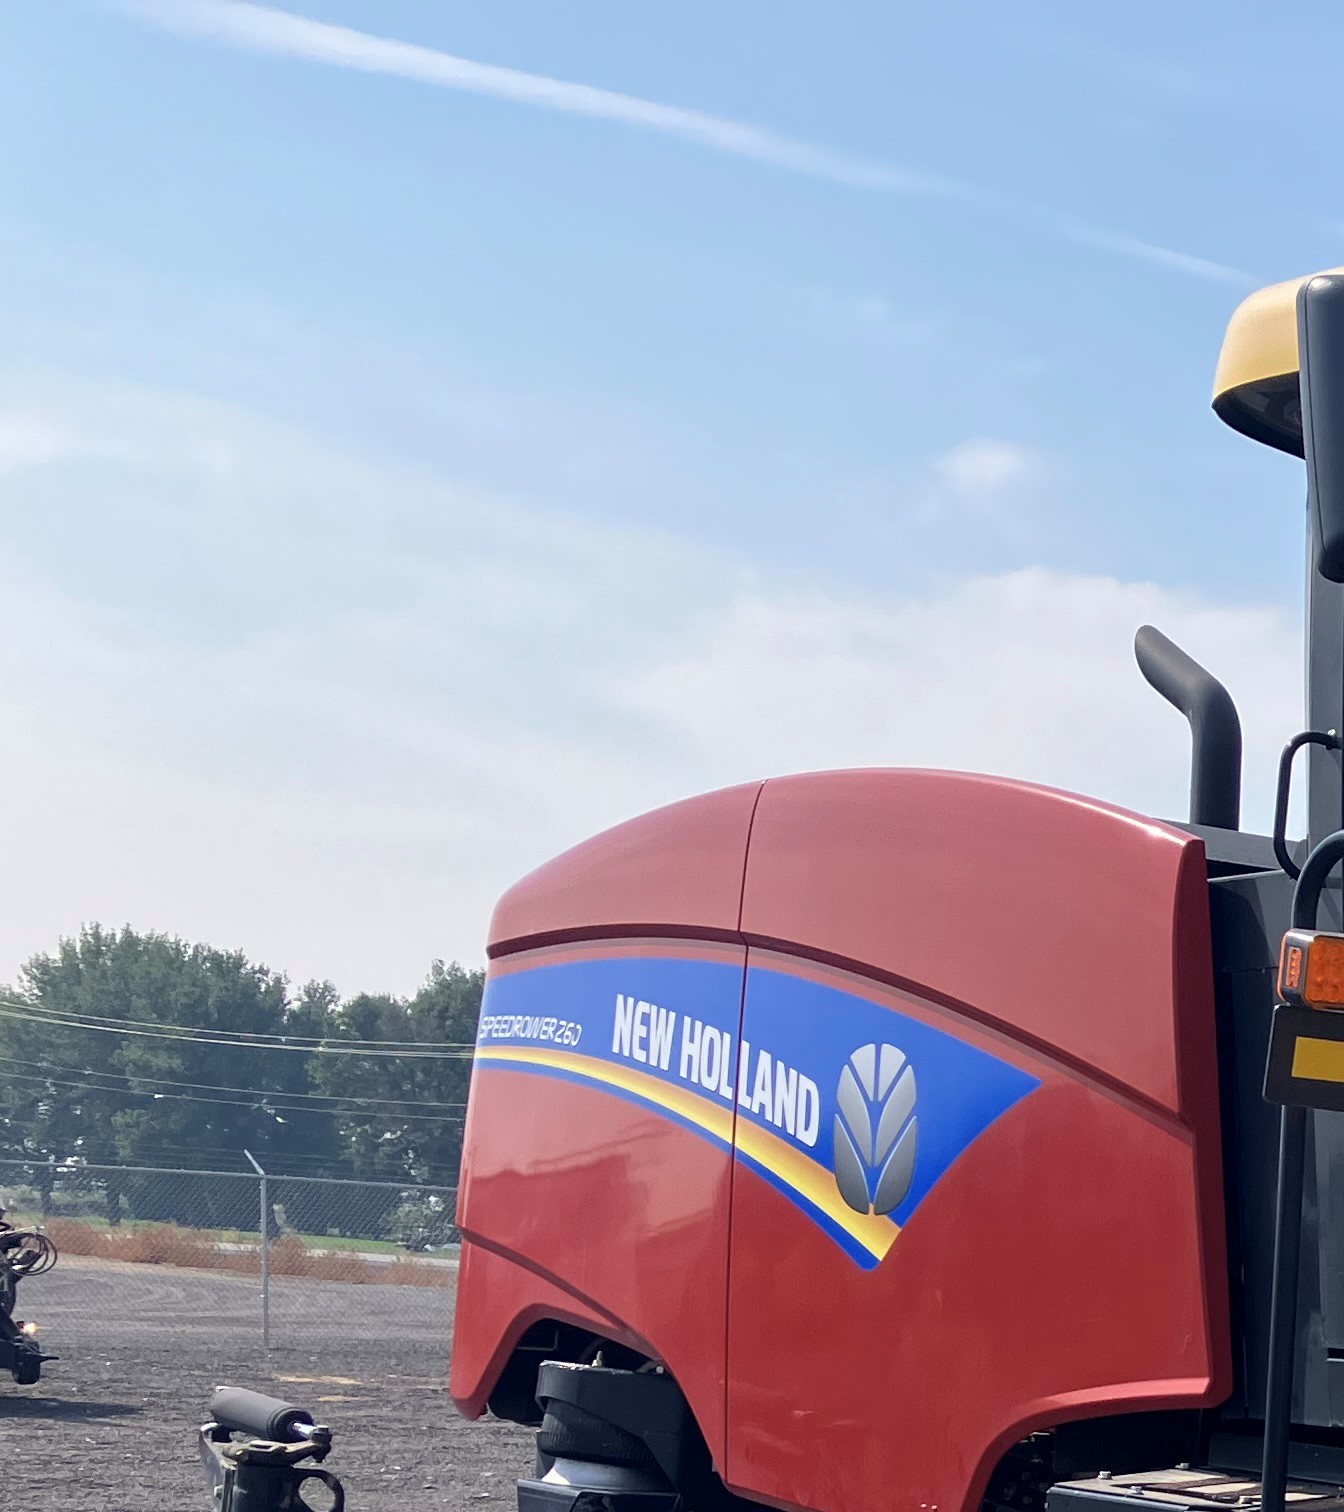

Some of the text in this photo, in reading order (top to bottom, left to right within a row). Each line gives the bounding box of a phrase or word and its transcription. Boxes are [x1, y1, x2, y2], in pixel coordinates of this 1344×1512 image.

[479, 1015, 583, 1047] SPEEDROWER 260
[612, 994, 820, 1148] NEW HOLLAND
